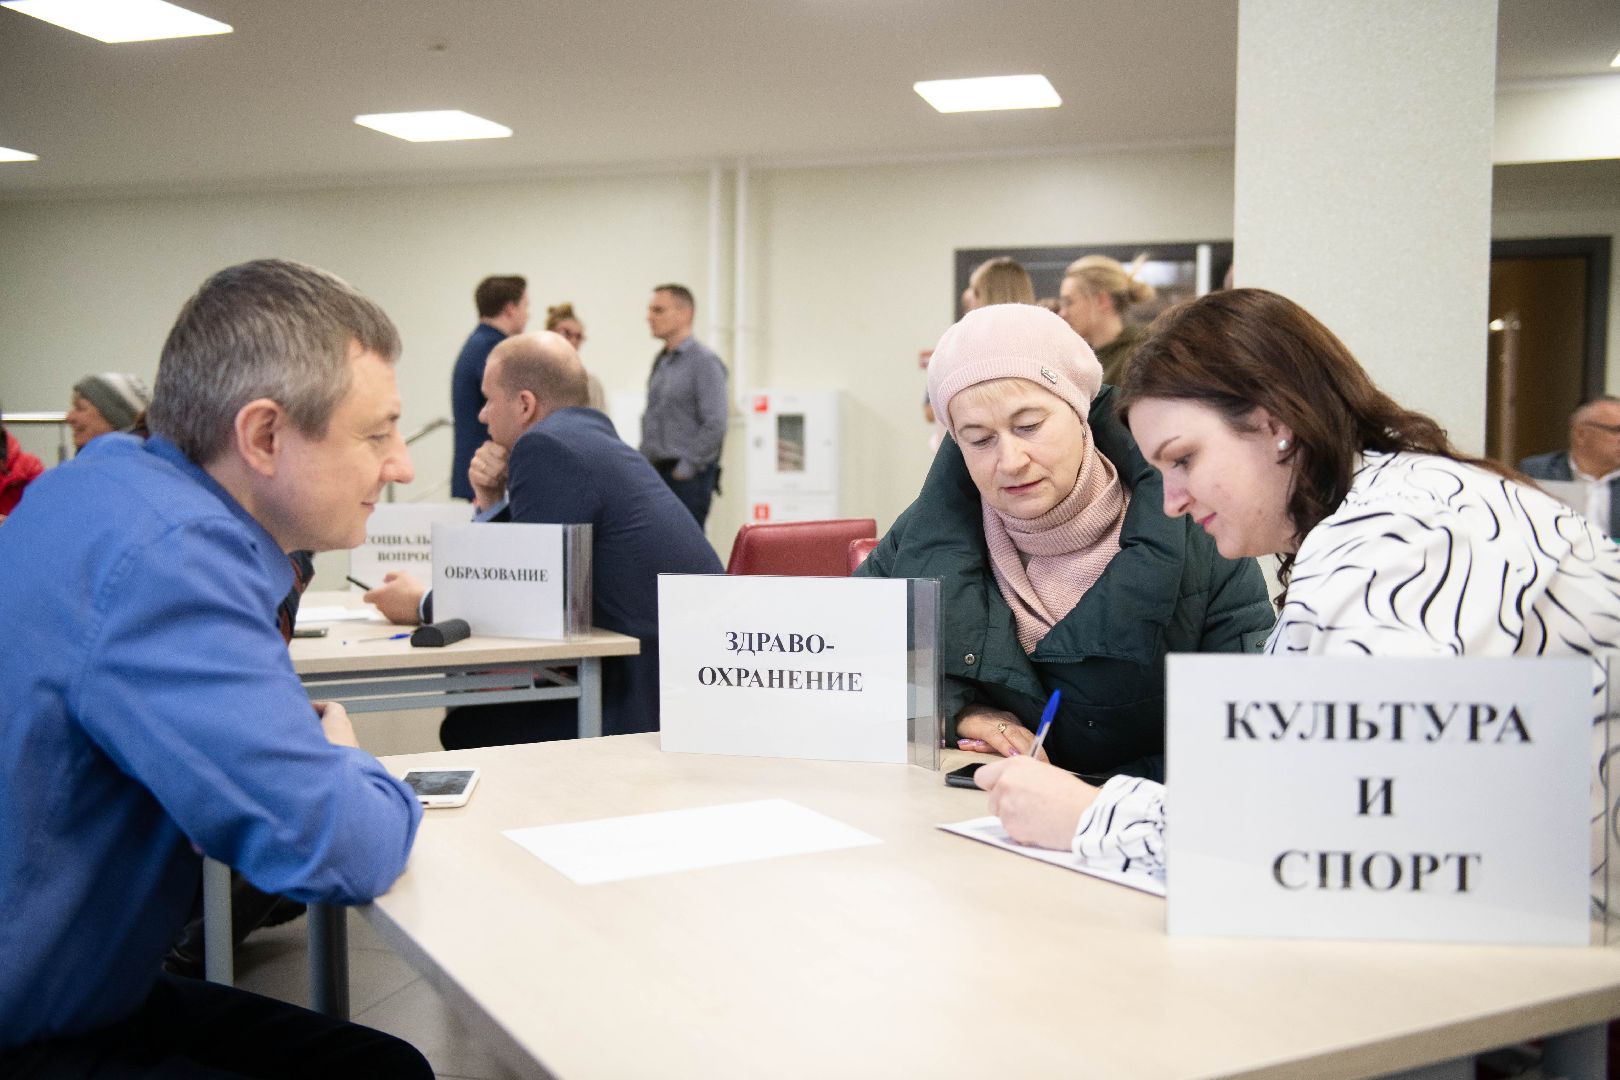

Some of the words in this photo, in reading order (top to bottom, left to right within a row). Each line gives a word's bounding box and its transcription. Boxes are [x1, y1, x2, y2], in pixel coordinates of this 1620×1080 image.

[444, 566, 548, 583] ОБРАЗОВАНИЕ
[725, 631, 835, 656] ЗДРАВО-
[698, 666, 863, 692] ОХРАНЕНИЕ
[1226, 701, 1533, 744] КУЛЬТУРА
[1357, 776, 1394, 817] И
[1272, 850, 1482, 893] СПОРТ
